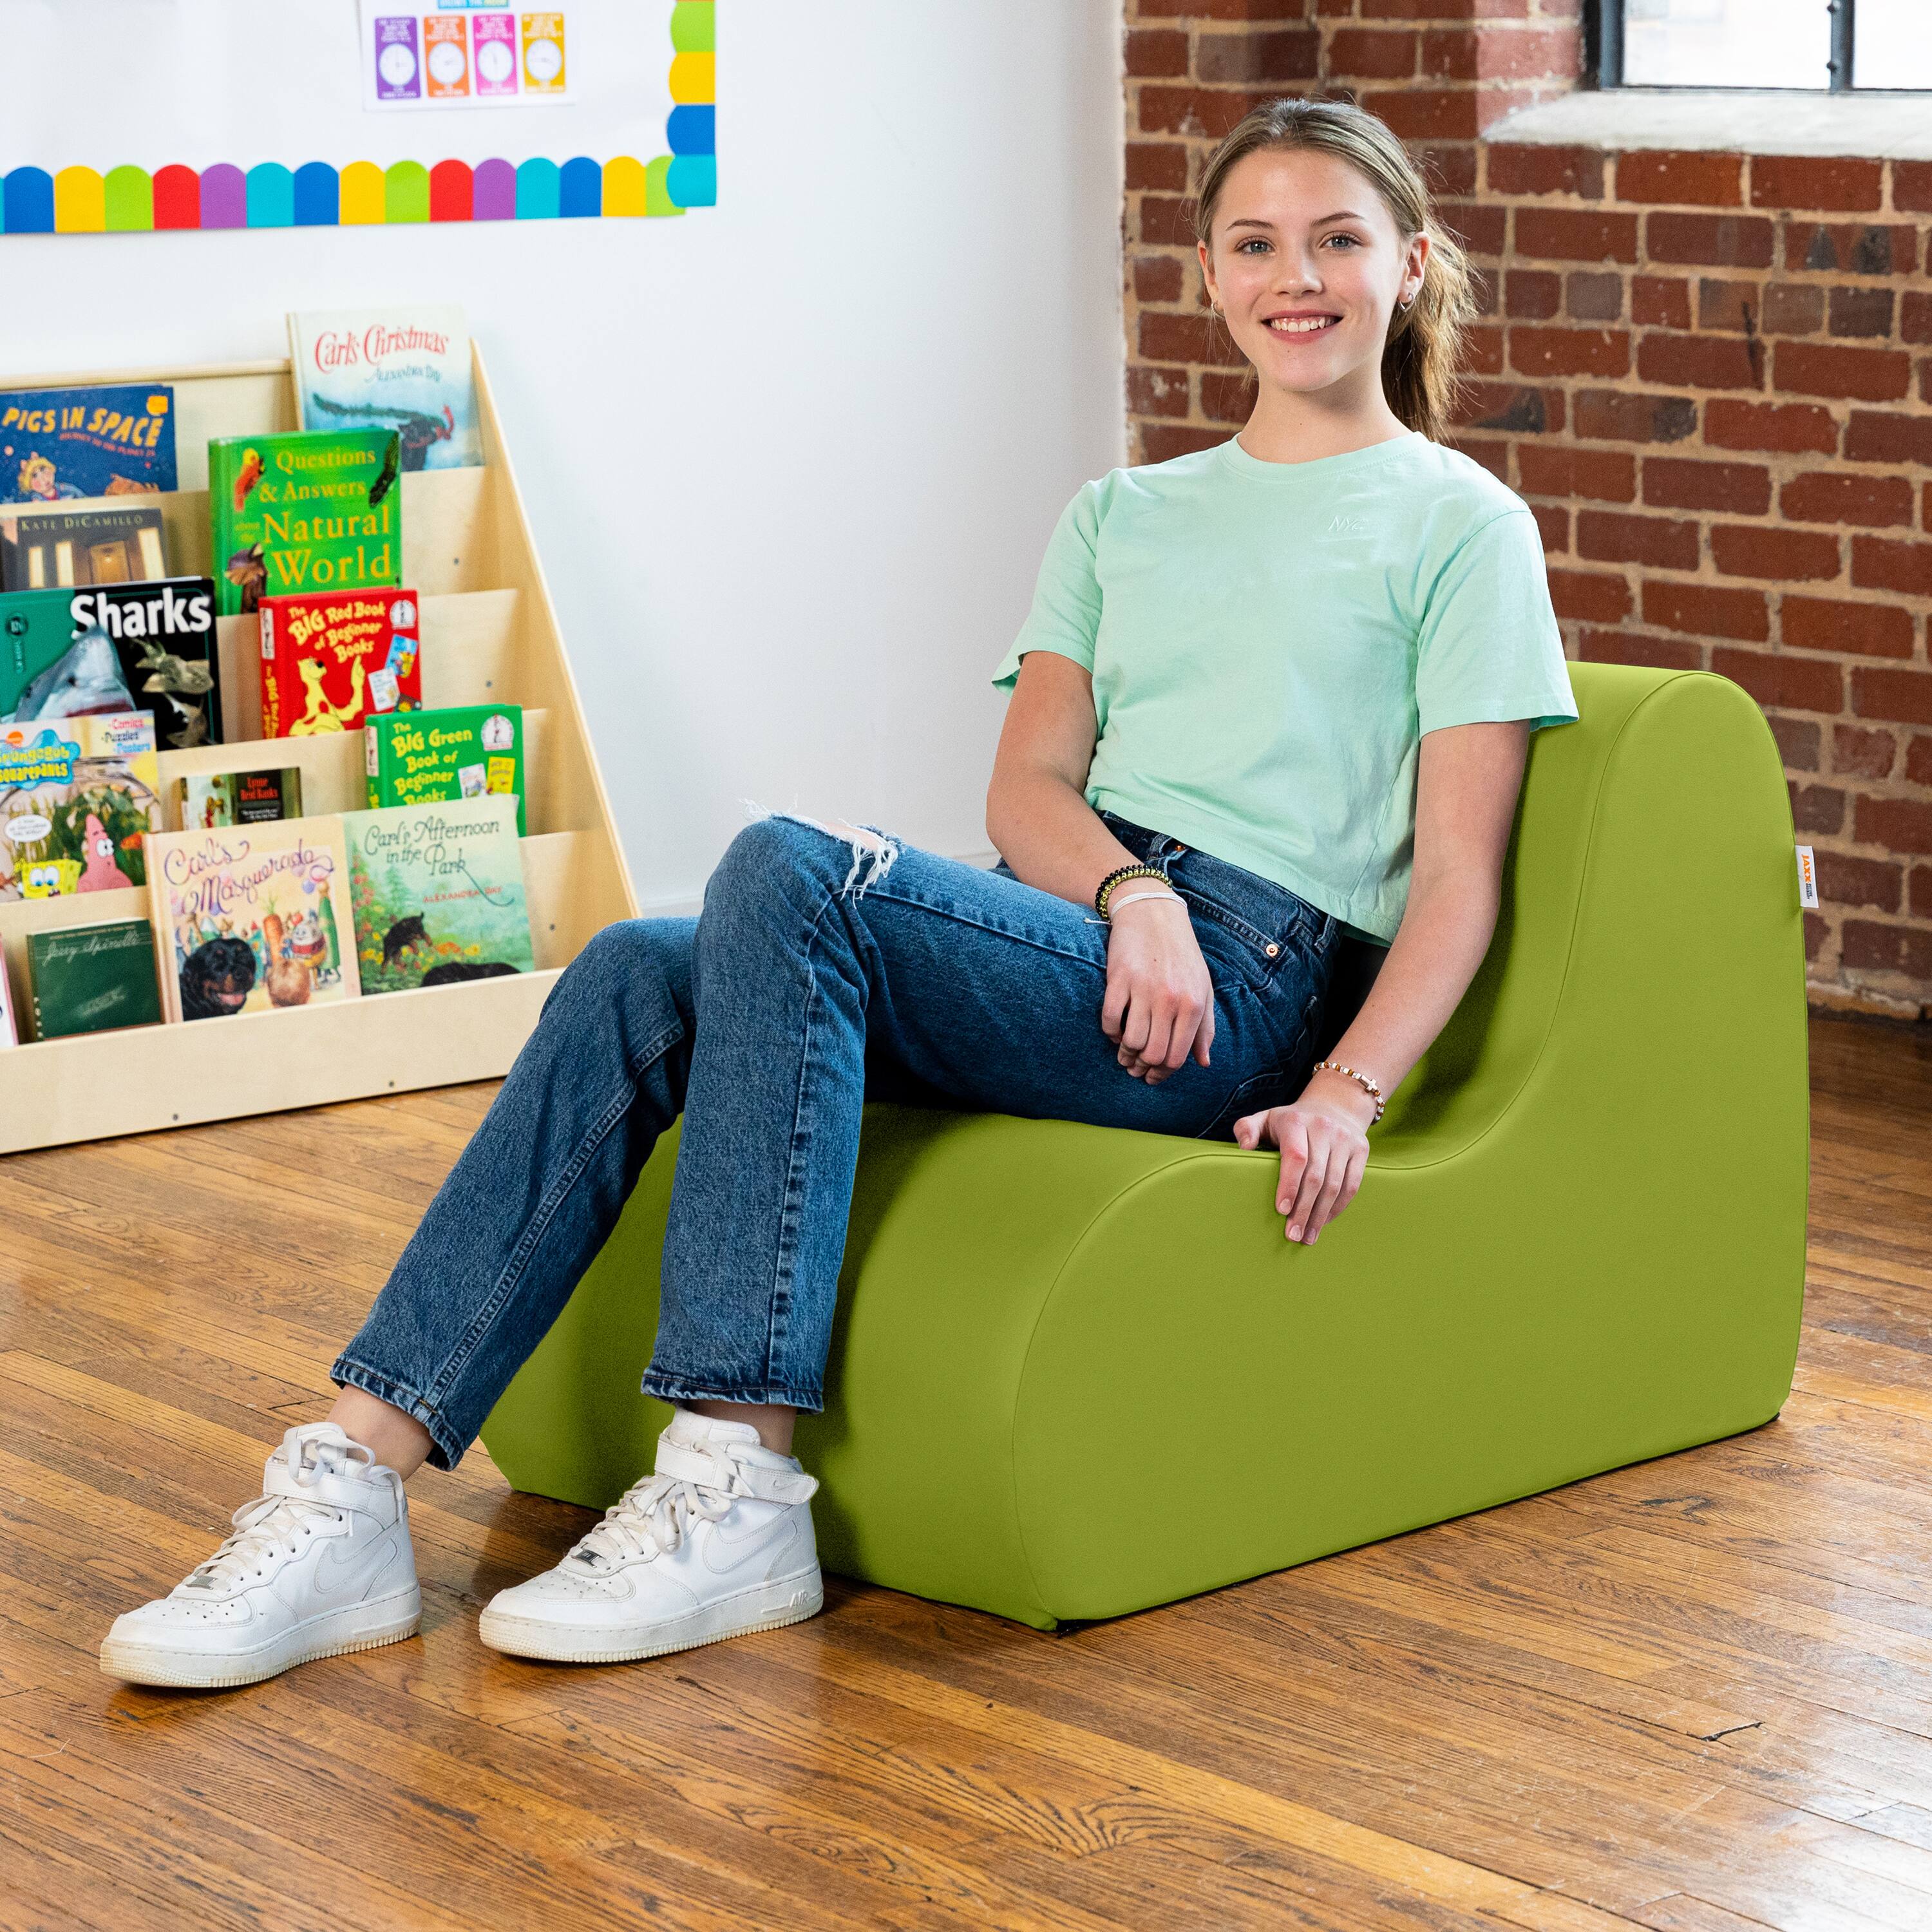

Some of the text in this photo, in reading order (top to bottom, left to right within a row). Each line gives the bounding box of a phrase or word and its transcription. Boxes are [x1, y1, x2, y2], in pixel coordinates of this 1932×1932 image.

[315, 323, 449, 374] Carl's Christmas
[2, 407, 56, 433] PIGS
[62, 406, 86, 430] IN
[86, 408, 164, 447] SPACE
[276, 446, 376, 475] Questions
[260, 480, 366, 502] & Answers
[21, 520, 55, 531] KATE
[263, 504, 390, 544] Natural
[272, 543, 390, 586] World
[70, 587, 212, 639] Sharks
[288, 606, 307, 618] The
[288, 609, 326, 646] BIG
[325, 603, 353, 624] Red
[354, 601, 386, 618] Book
[314, 622, 383, 650] of Beginner
[334, 638, 375, 663] Books
[392, 732, 424, 758] BIG
[428, 728, 473, 747] Green
[393, 723, 412, 734] The
[406, 750, 459, 773] Book of
[394, 772, 454, 796] Beginner
[403, 788, 446, 806] Books
[365, 816, 500, 855] Carl's Afternoon
[164, 837, 250, 886] Carl's
[386, 842, 466, 876] in the Park
[181, 838, 334, 915] Masquerade
[790, 1589, 808, 1607] AIR
